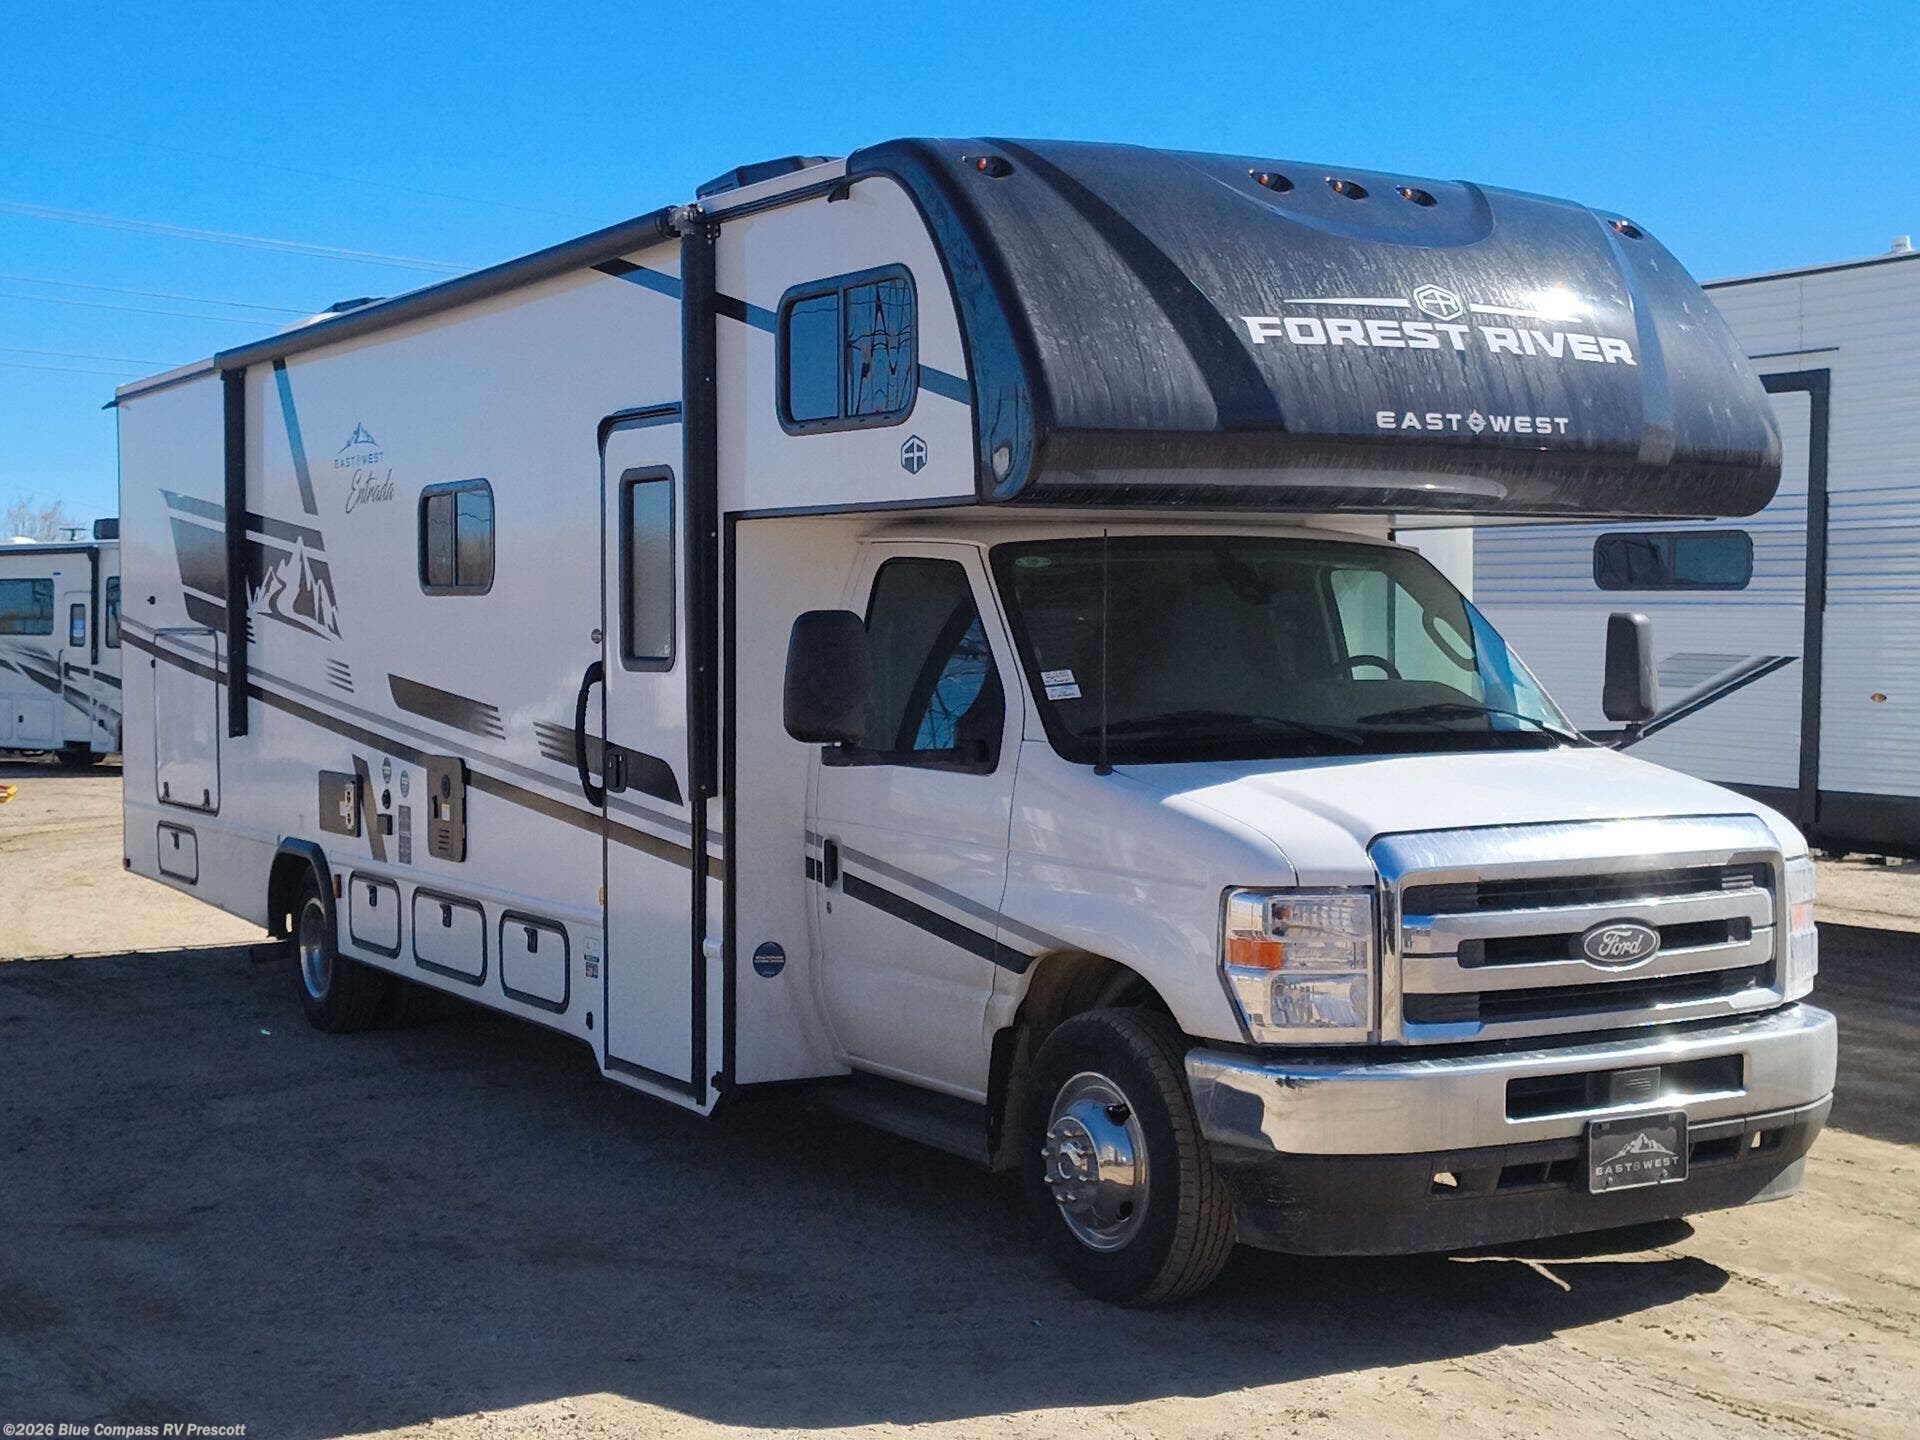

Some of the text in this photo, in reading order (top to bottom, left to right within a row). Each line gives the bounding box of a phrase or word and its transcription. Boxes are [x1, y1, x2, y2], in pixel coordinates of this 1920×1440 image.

[1242, 316, 1637, 366] FOREST RIVER
[1376, 411, 1569, 434] EAST WEST
[345, 468, 394, 514] Entrada
[1599, 930, 1643, 956] Ford
[1595, 1156, 1680, 1176] EAST WEST
